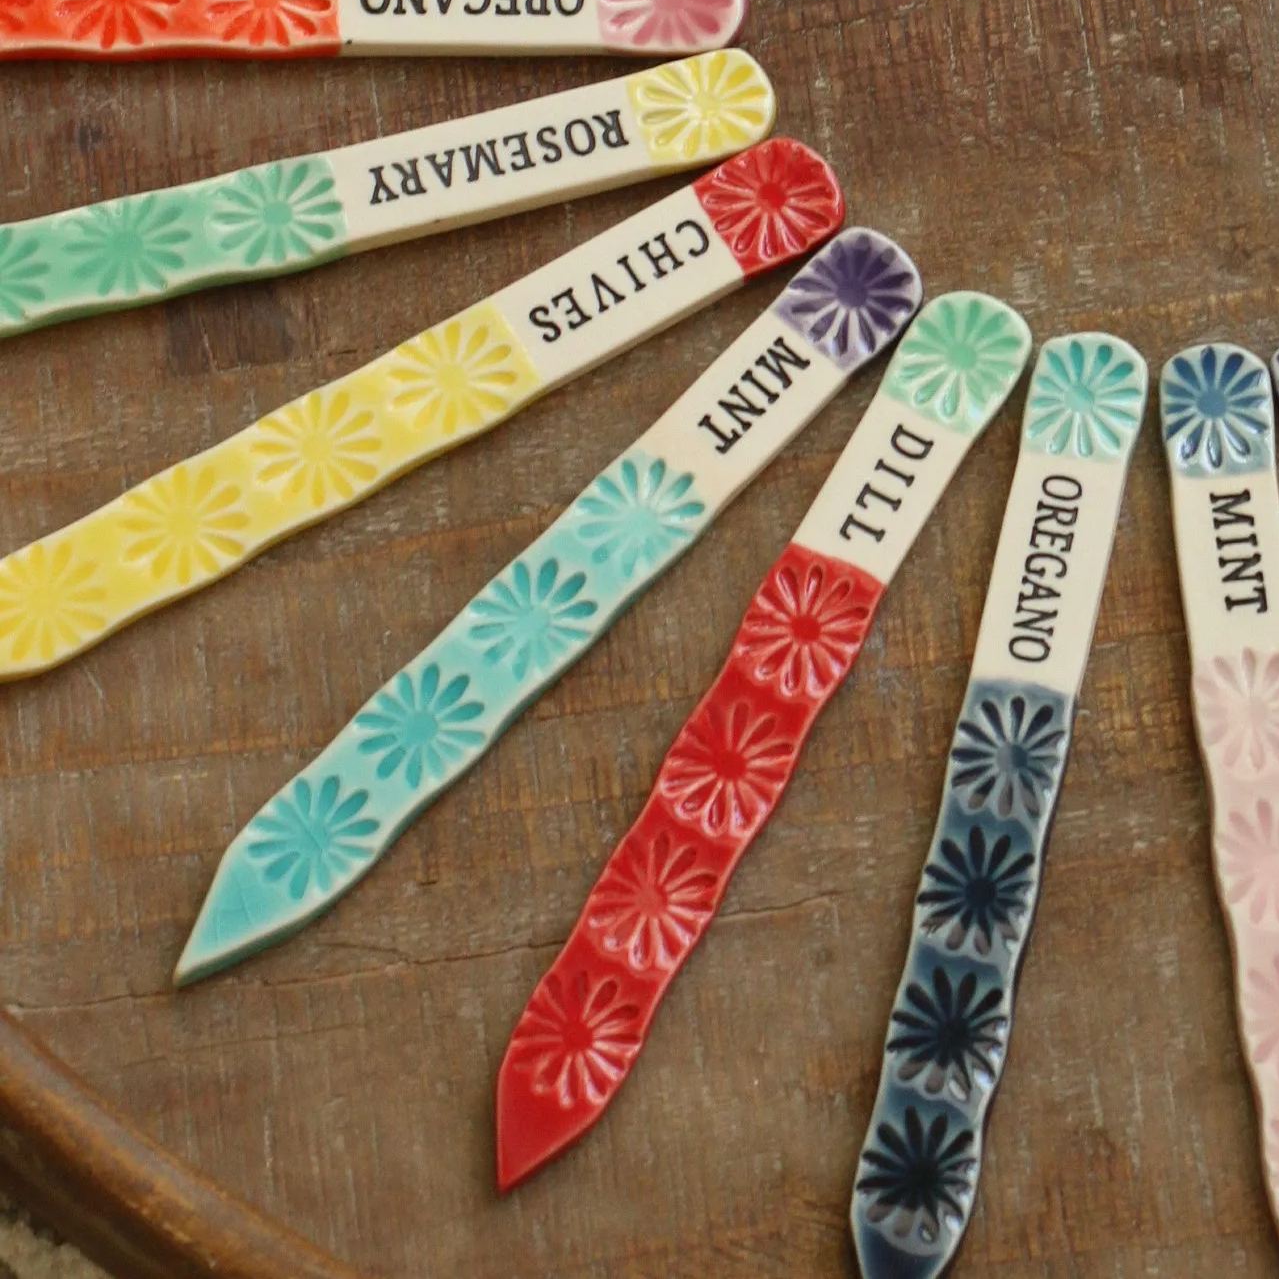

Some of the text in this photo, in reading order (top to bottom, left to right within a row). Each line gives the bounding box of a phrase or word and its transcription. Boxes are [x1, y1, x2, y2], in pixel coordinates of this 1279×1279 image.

[369, 109, 630, 205] ROSEMARY
[528, 219, 710, 343] CHIVES
[697, 336, 811, 454] MINT
[839, 424, 934, 542] DILL
[1008, 475, 1083, 663] OREGANO
[1209, 489, 1268, 614] MINT
